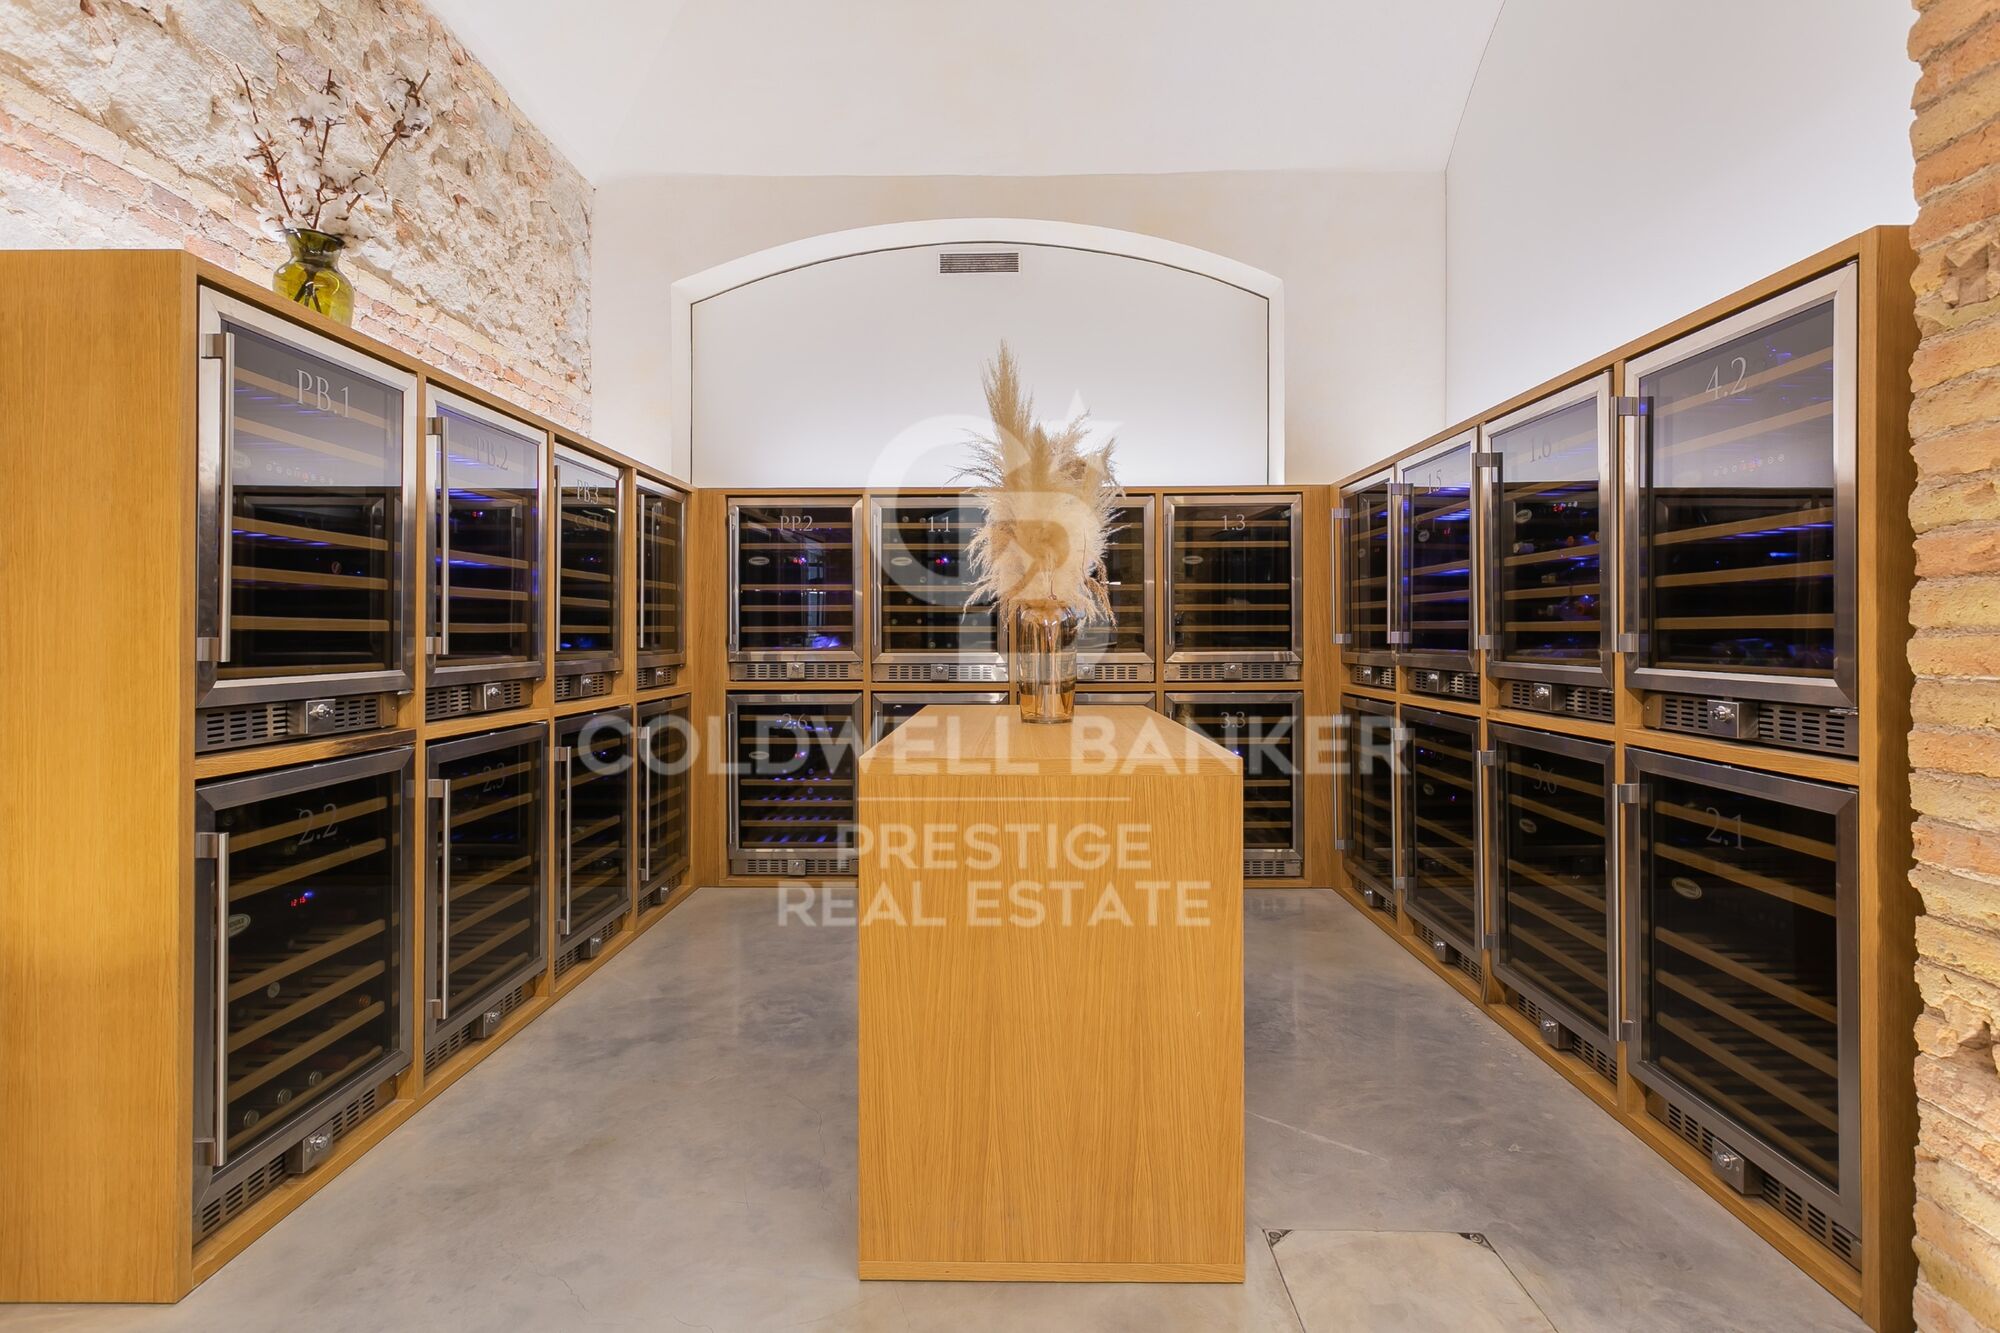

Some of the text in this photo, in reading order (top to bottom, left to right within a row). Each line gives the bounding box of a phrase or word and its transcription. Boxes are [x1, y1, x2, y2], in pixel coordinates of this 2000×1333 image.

[296, 368, 351, 418] PB.1
[1705, 356, 1748, 400] 4.2
[475, 434, 508, 471] PB.2
[576, 479, 599, 505] PB.3
[779, 515, 813, 532] PP.2
[928, 516, 950, 533] 1.1
[1221, 513, 1246, 531] 1.3
[1220, 711, 1246, 729] 3.3
[298, 803, 338, 846] 2.2
[1706, 807, 1745, 851] 2.1
